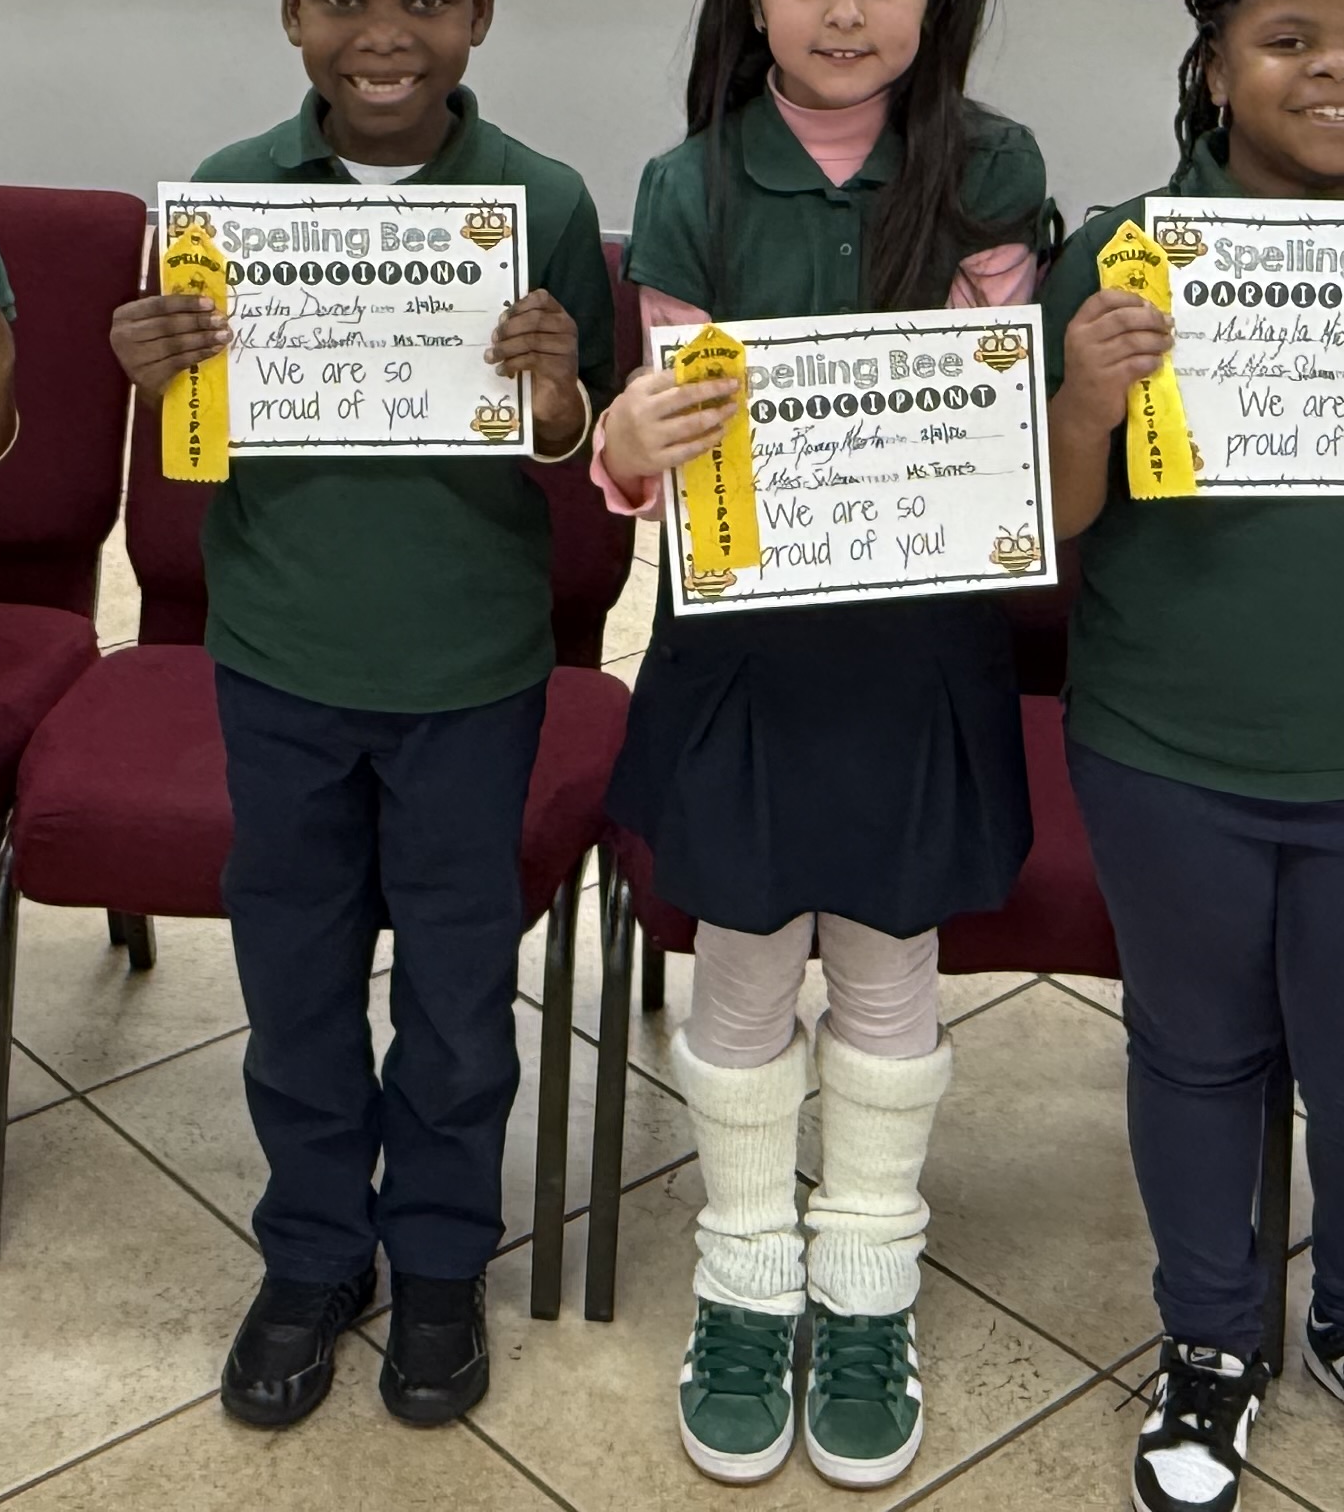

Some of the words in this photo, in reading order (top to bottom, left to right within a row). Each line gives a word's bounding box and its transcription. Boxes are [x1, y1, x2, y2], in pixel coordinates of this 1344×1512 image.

[222, 219, 370, 260] Spelling
[380, 221, 452, 254] Bee
[1102, 248, 1161, 269] SPELLING
[226, 261, 480, 285] ARTICIPANT
[255, 355, 305, 385] We
[321, 364, 367, 385] are
[383, 361, 413, 383] so
[747, 353, 879, 399] pelling
[888, 349, 964, 381] Bee
[189, 363, 201, 468] RTICIPANT
[249, 391, 320, 430] proud
[337, 390, 365, 420] of
[382, 389, 429, 430] you!
[757, 389, 992, 422] RTICIPANT
[1238, 386, 1285, 418] We
[1140, 379, 1164, 484] TICIPANT
[1226, 425, 1298, 467] proud
[1316, 425, 1344, 457] of
[712, 449, 732, 557] RTICIPANT
[763, 498, 814, 530] We
[832, 500, 879, 524] are
[896, 495, 927, 520] so
[758, 532, 832, 580] proud
[850, 529, 878, 561] of
[897, 524, 946, 570] you!
